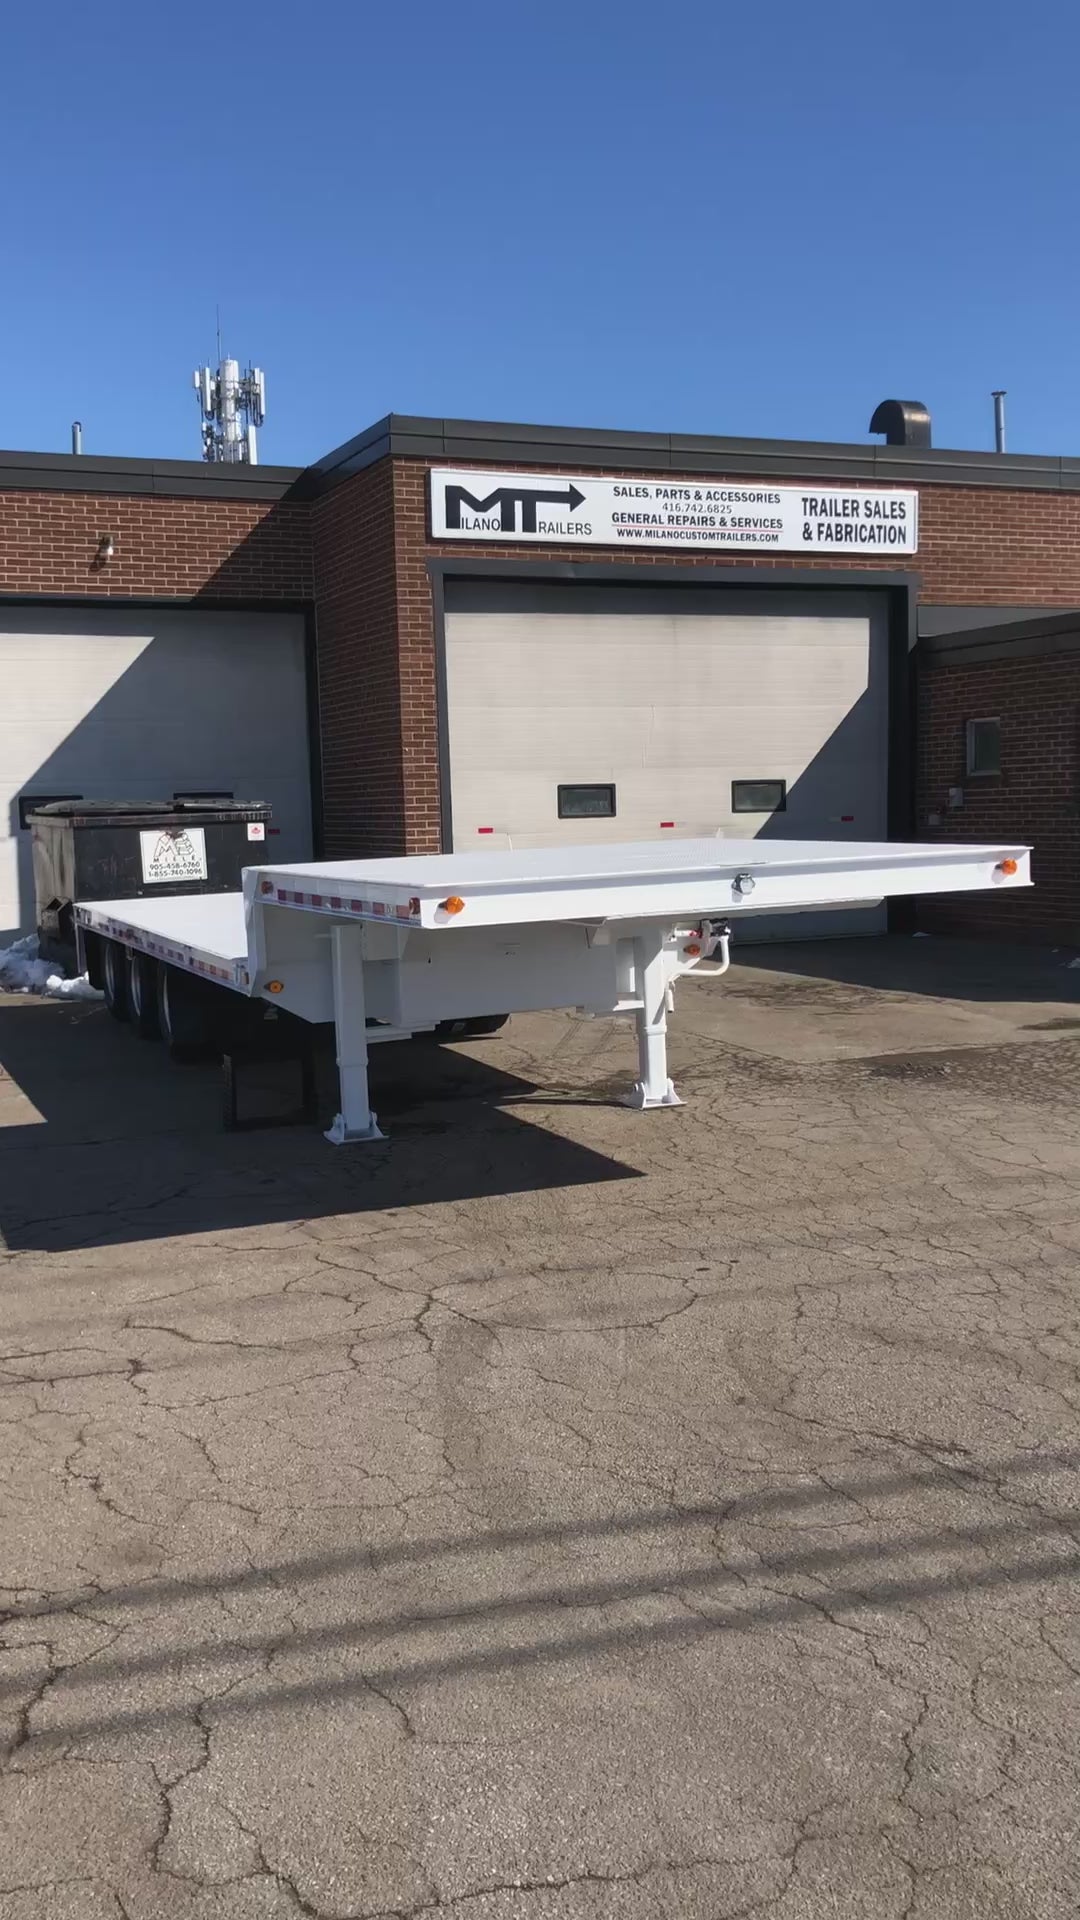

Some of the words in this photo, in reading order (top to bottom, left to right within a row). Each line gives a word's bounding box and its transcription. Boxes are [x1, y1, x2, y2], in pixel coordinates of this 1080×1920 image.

[613, 486, 652, 499] SALES,
[656, 488, 691, 500] PARTS
[694, 491, 702, 501] &
[706, 491, 781, 504] ACCESSORIES
[662, 502, 732, 514] 416.742.6825
[802, 497, 860, 518] TRAILER
[864, 499, 907, 520] SALES
[612, 512, 664, 525] GENERAL
[668, 515, 716, 527] REPAIRS
[719, 518, 727, 528] &
[731, 518, 783, 529] SERVICES
[617, 528, 779, 543] WWW.MILANOCUSTOMTRAILERS.COM
[802, 522, 813, 541] &
[817, 522, 907, 544] FABRICATION
